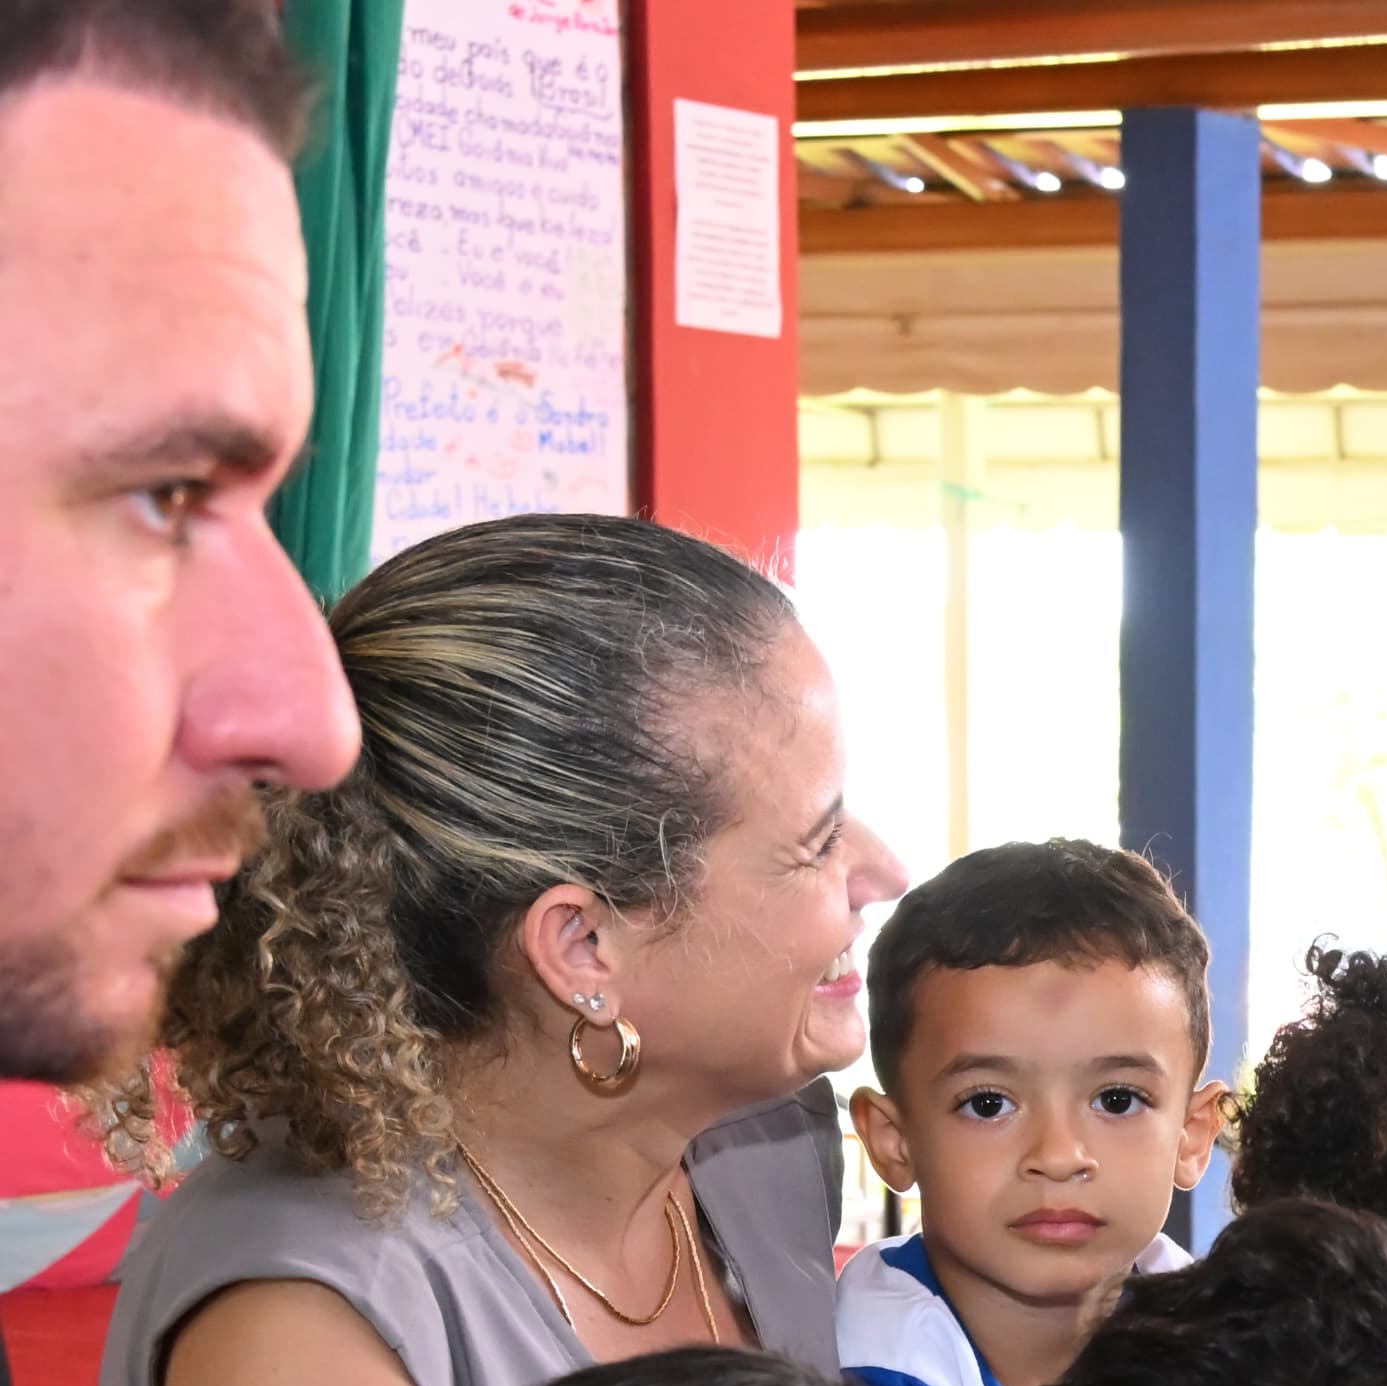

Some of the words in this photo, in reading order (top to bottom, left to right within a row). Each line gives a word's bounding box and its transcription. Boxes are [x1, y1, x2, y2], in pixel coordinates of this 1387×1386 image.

[408, 27, 456, 51] meu
[522, 49, 562, 95] que
[397, 111, 450, 151] CMEI
[453, 170, 525, 212] amigos
